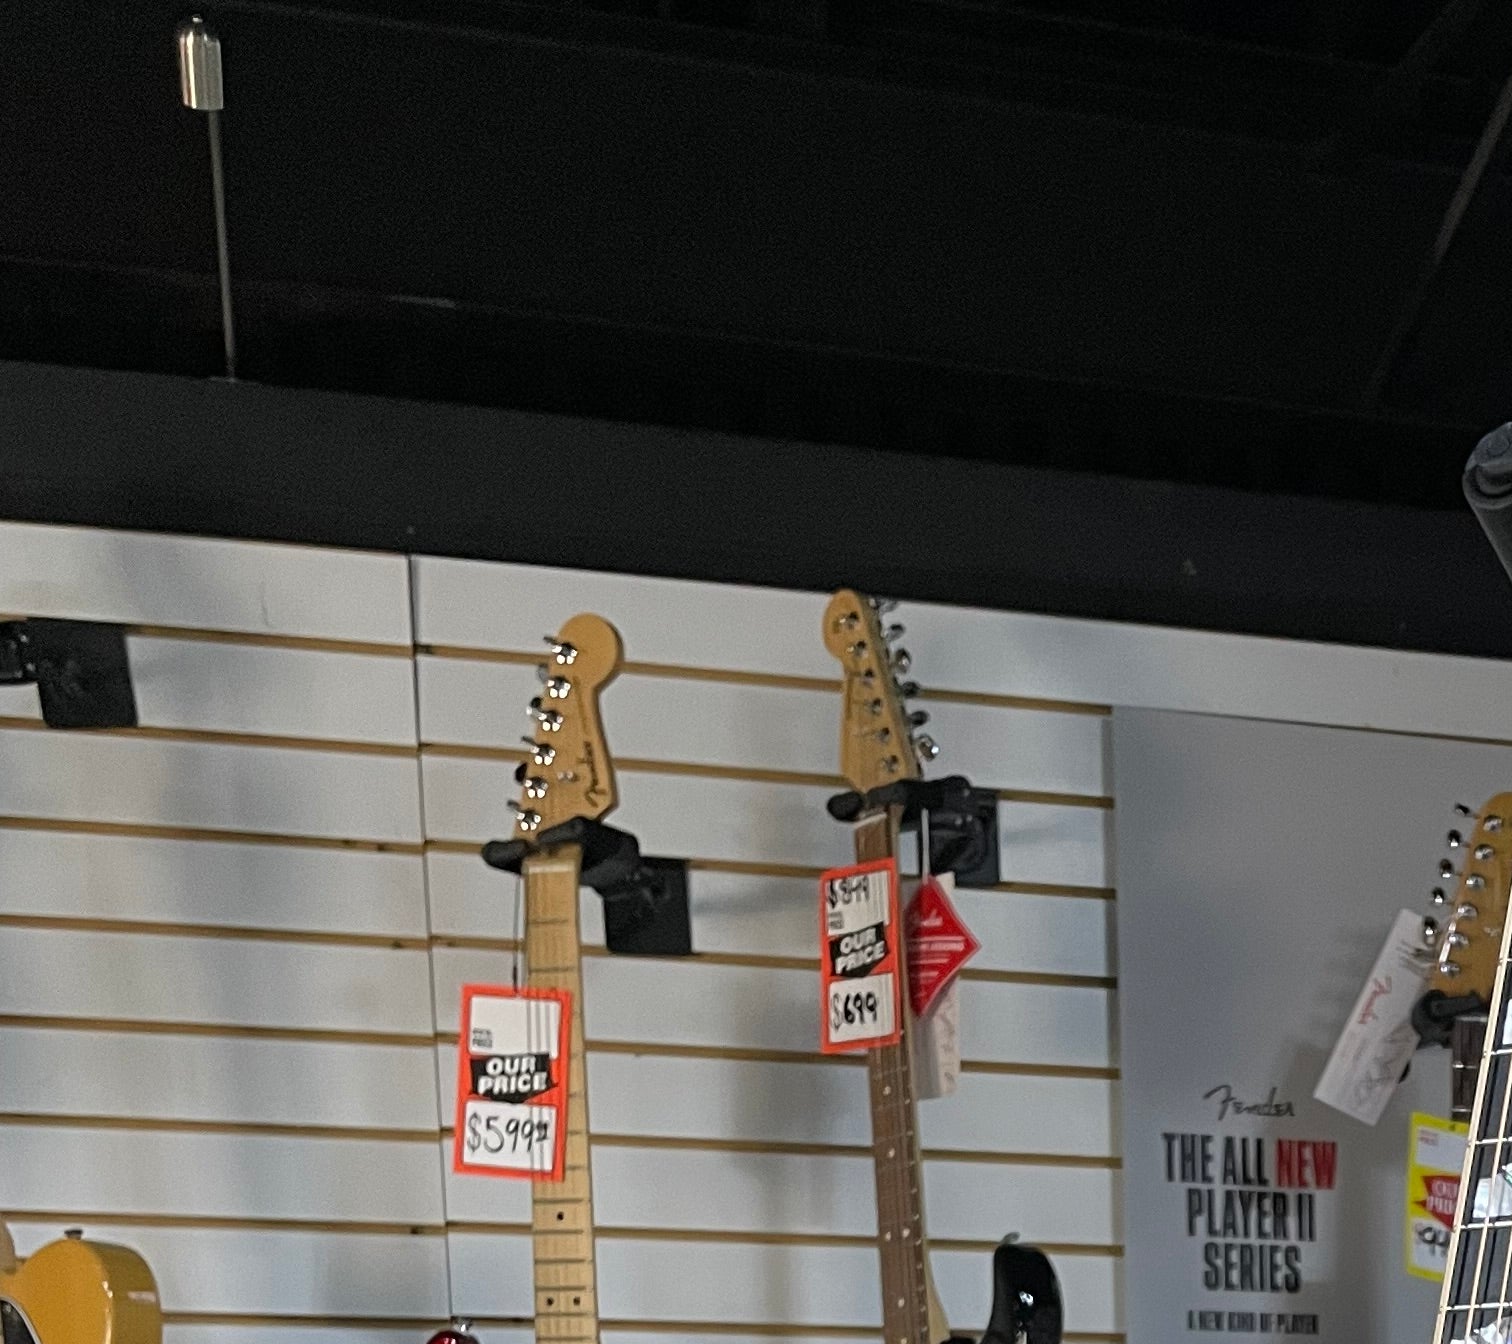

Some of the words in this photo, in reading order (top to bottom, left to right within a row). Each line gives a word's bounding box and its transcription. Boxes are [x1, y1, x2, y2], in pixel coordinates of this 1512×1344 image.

[835, 941, 886, 975] PRICE
[839, 927, 877, 955] OUR
[831, 991, 880, 1032] $699
[477, 1072, 548, 1095] PRICE
[485, 1056, 537, 1077] OUR
[1202, 1084, 1296, 1121] Fender
[1162, 1132, 1214, 1184] THE
[1223, 1135, 1270, 1186] ALL
[1275, 1137, 1338, 1190] NEW
[1431, 1179, 1460, 1198] OU
[1187, 1188, 1290, 1241] PLAYER
[1297, 1193, 1317, 1242] II
[1204, 1241, 1302, 1294] SERIES
